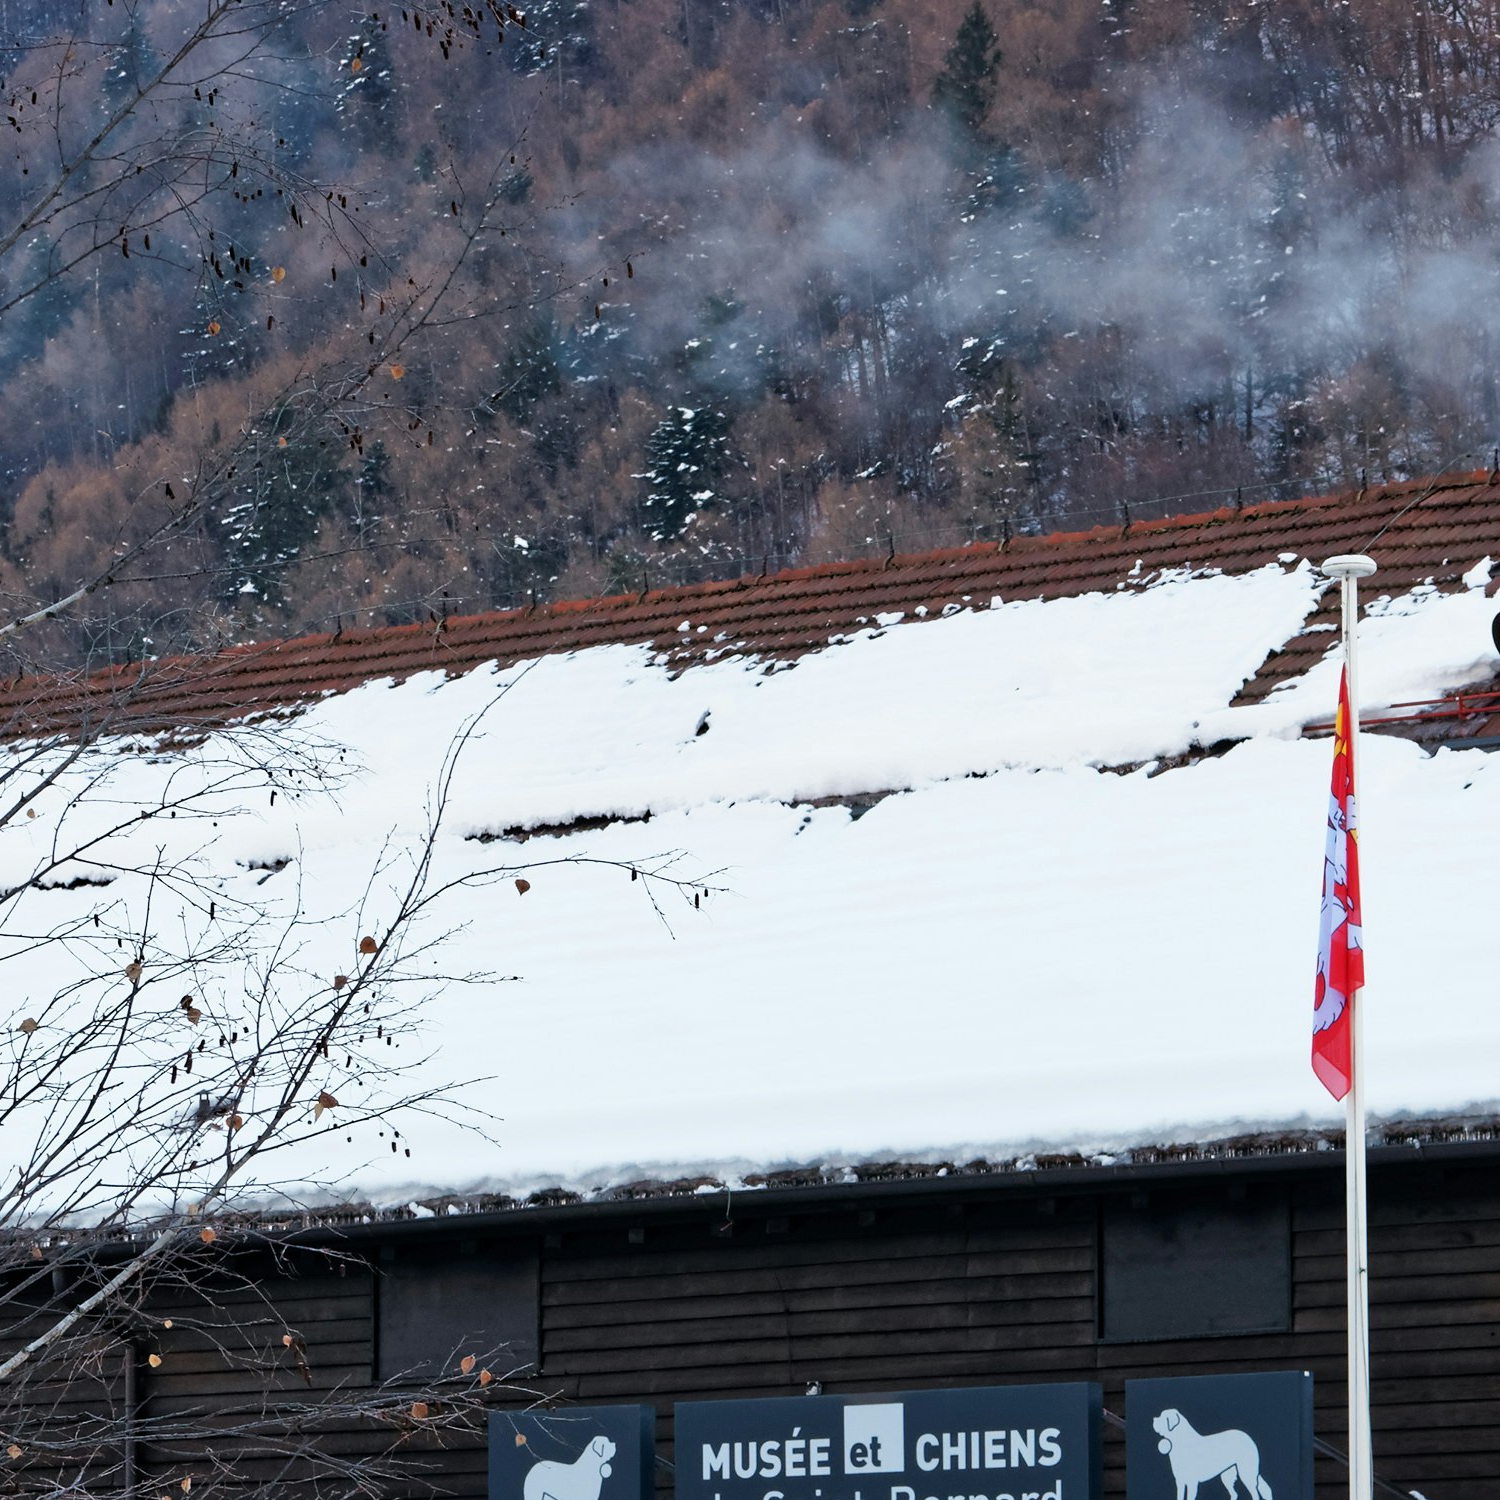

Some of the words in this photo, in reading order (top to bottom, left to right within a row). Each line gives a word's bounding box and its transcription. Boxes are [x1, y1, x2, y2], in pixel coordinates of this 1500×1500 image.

[702, 1426, 831, 1480] MUSÉE
[850, 1436, 882, 1468] et
[915, 1427, 1062, 1472] CHIENS
